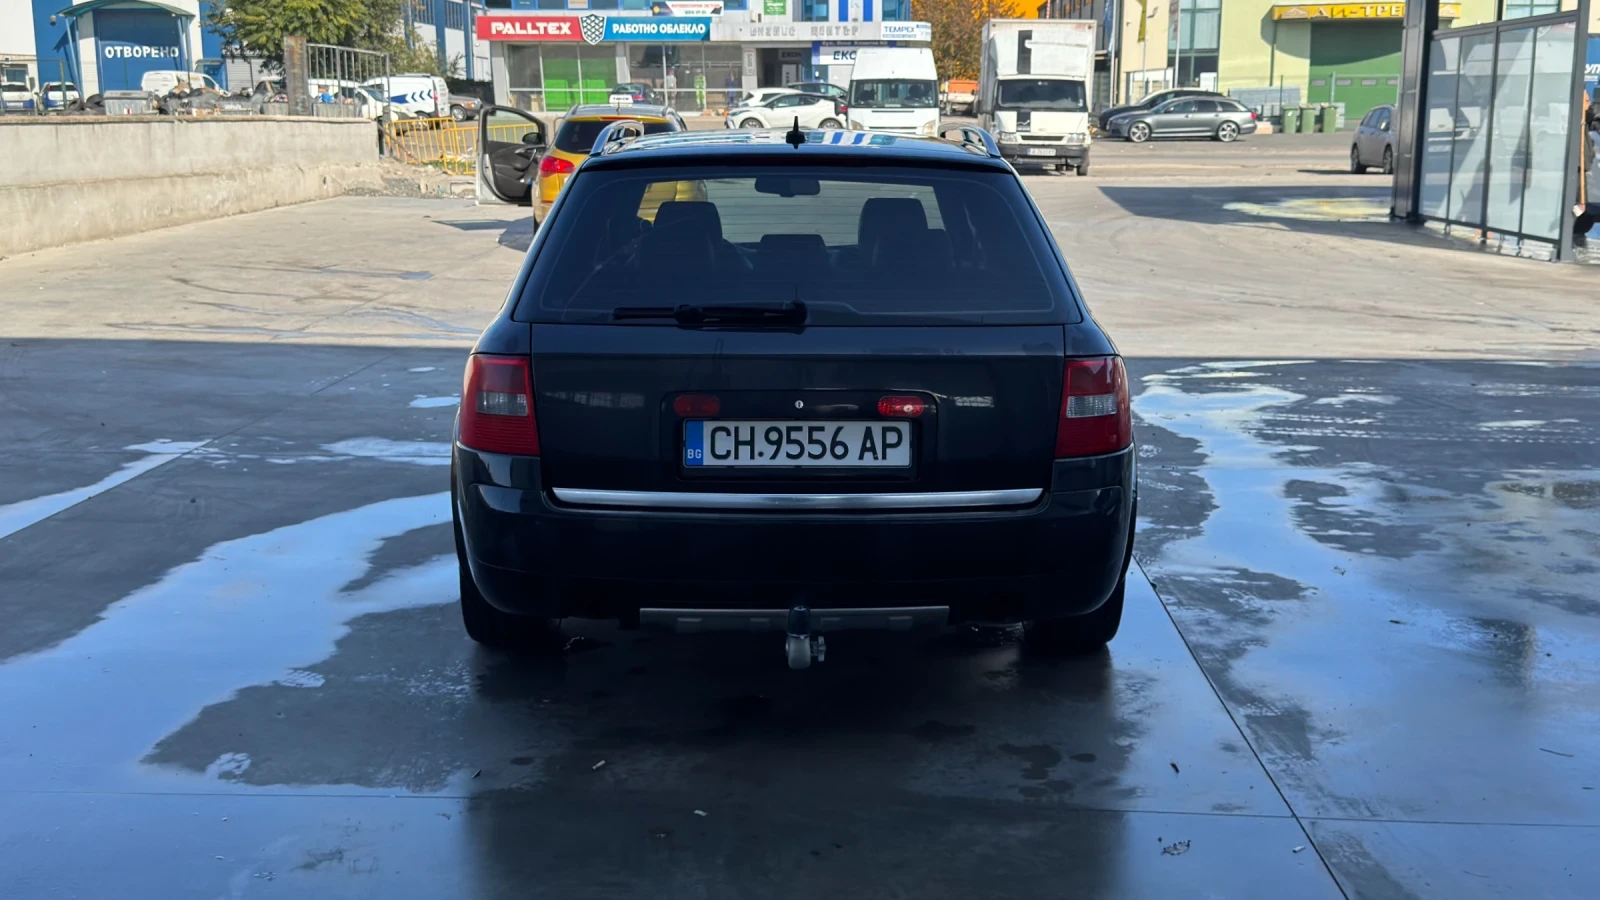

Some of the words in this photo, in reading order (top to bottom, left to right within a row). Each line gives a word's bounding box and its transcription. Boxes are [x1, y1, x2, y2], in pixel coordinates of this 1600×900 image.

[1309, 4, 1405, 19] ДИ-ТРЕ
[490, 22, 572, 34] PALLTEX
[612, 23, 658, 34] РАБОТНО
[659, 23, 706, 34] ОБЛЕКЛО
[883, 25, 915, 33] TEMPEX
[104, 46, 179, 59] ОТВОРЕНО
[857, 426, 903, 460] AP
[687, 448, 702, 459] BG
